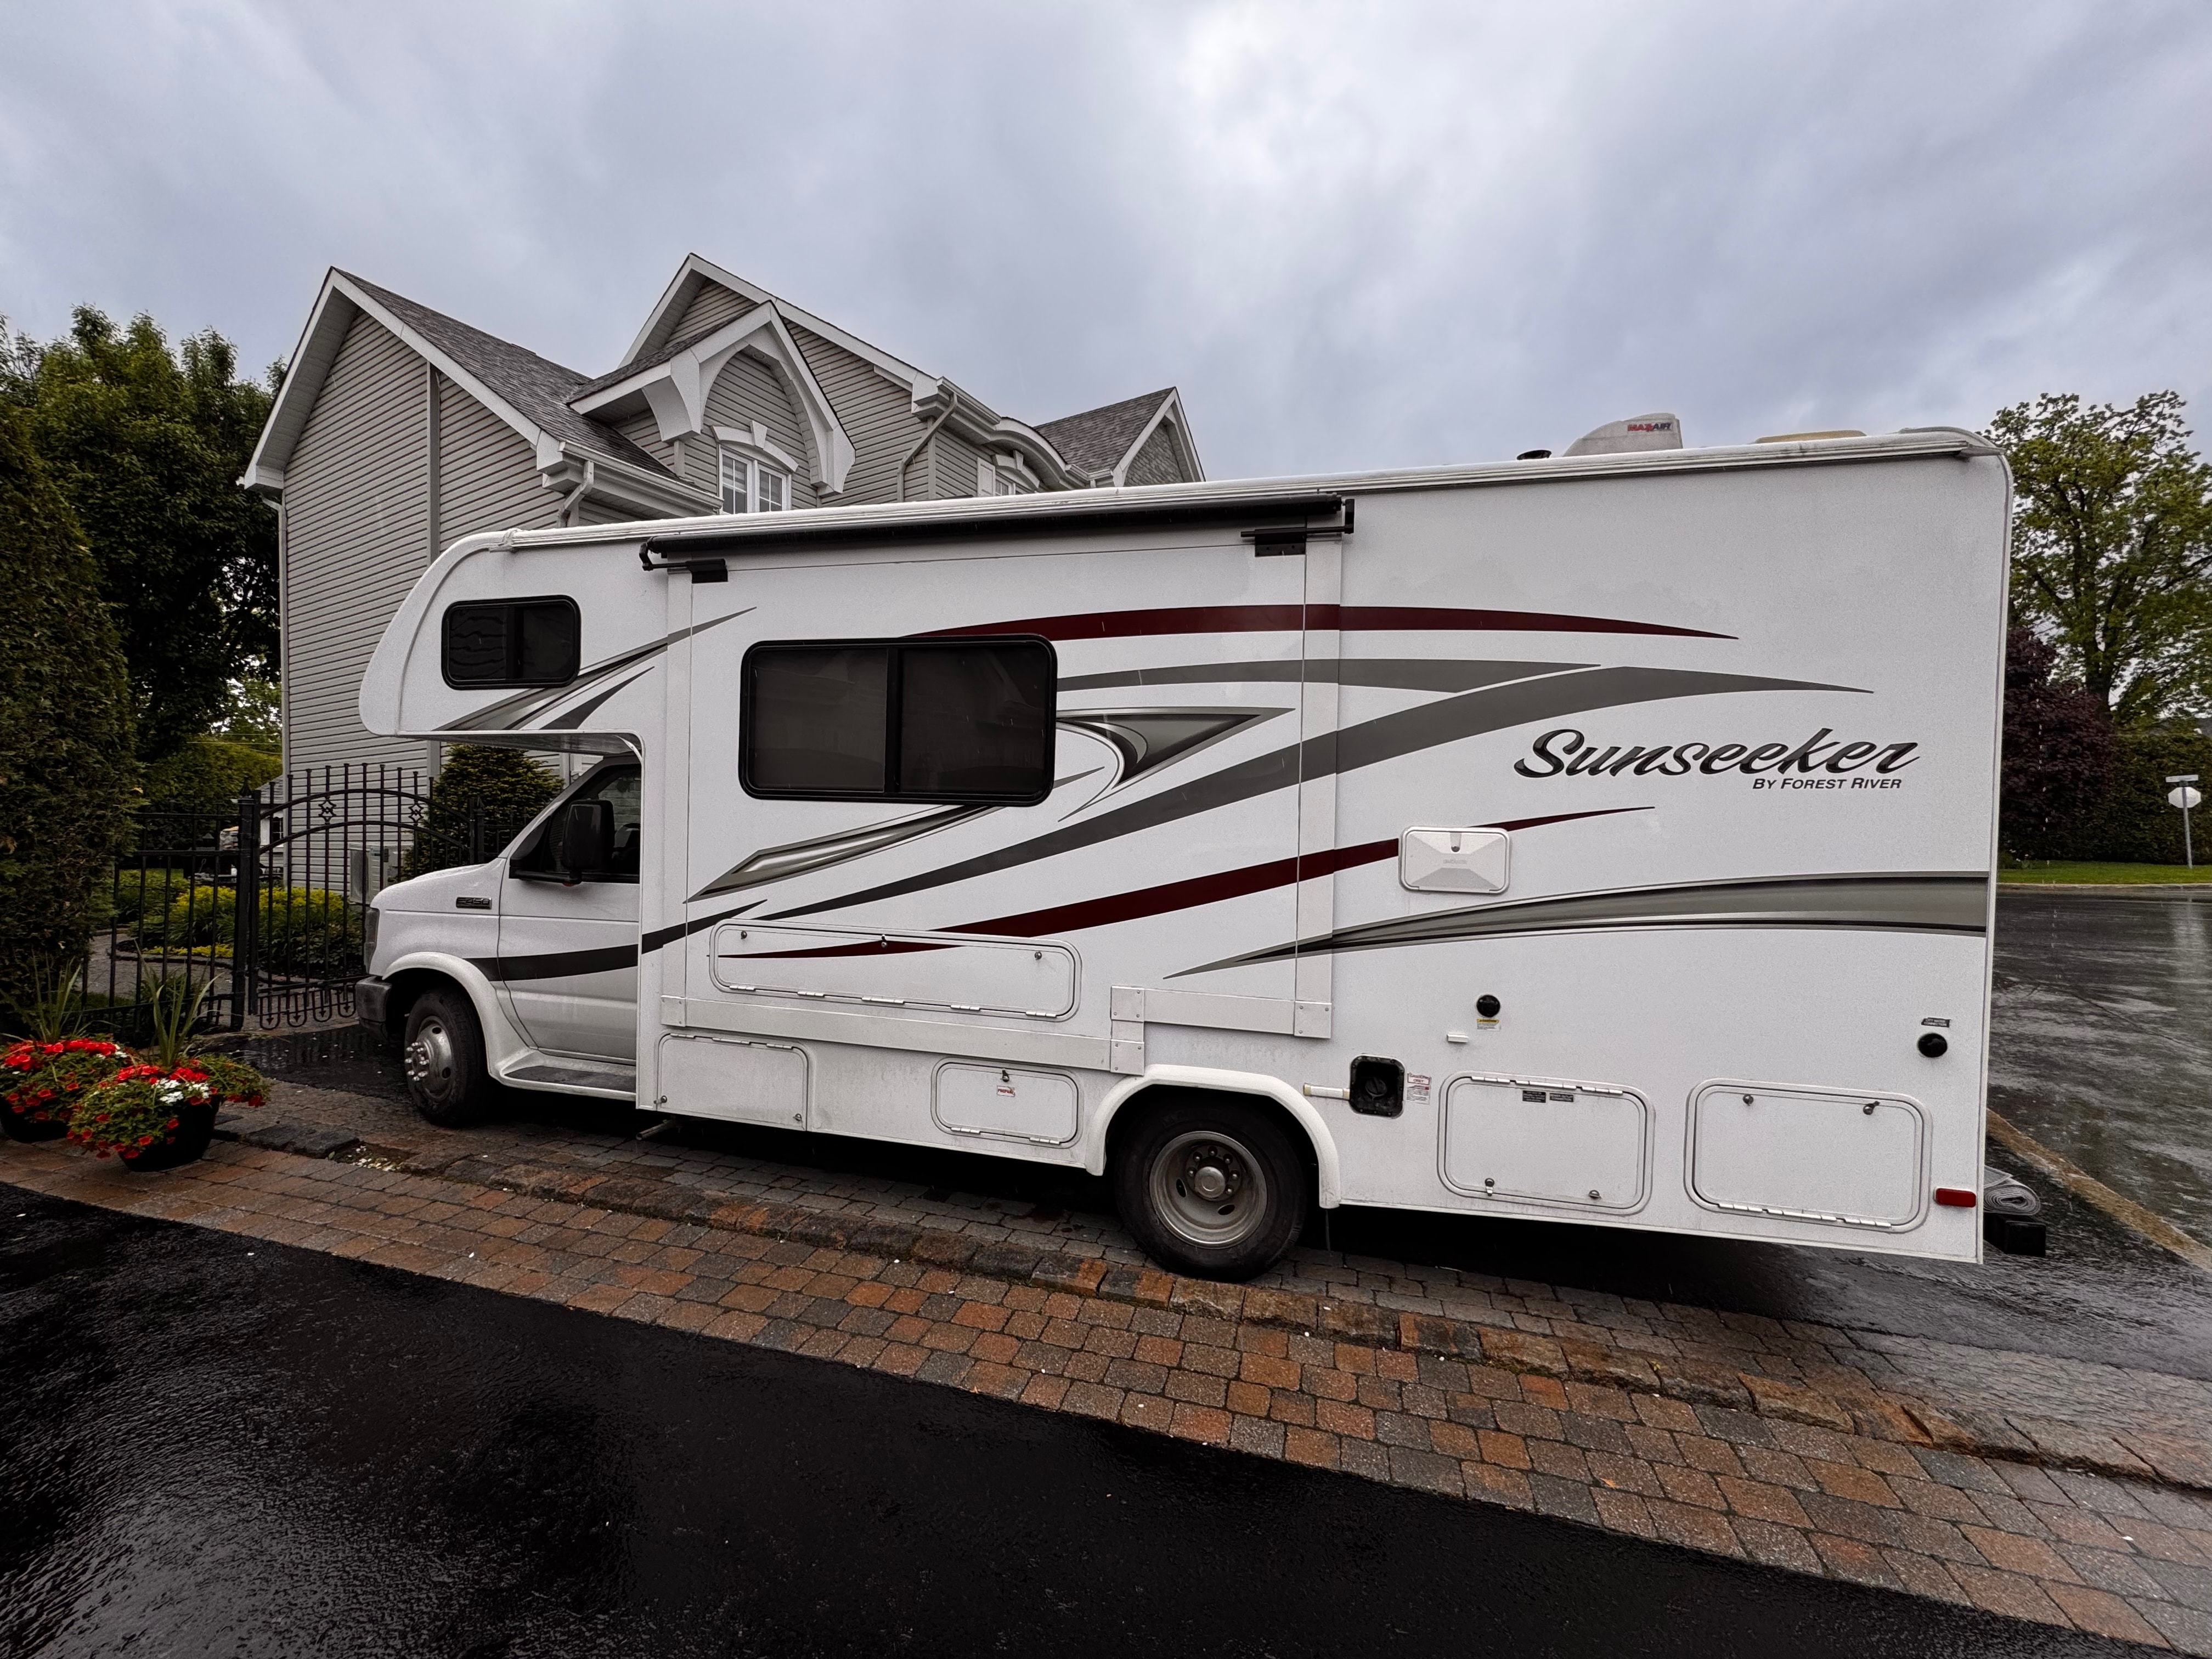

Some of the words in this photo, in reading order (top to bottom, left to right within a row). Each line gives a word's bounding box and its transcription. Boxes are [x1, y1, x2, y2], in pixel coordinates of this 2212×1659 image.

[1514, 727, 1921, 778] Sunseeker
[1752, 778, 1777, 789] BY
[1781, 778, 1847, 789] FOREST
[1850, 777, 1902, 789] RIVER
